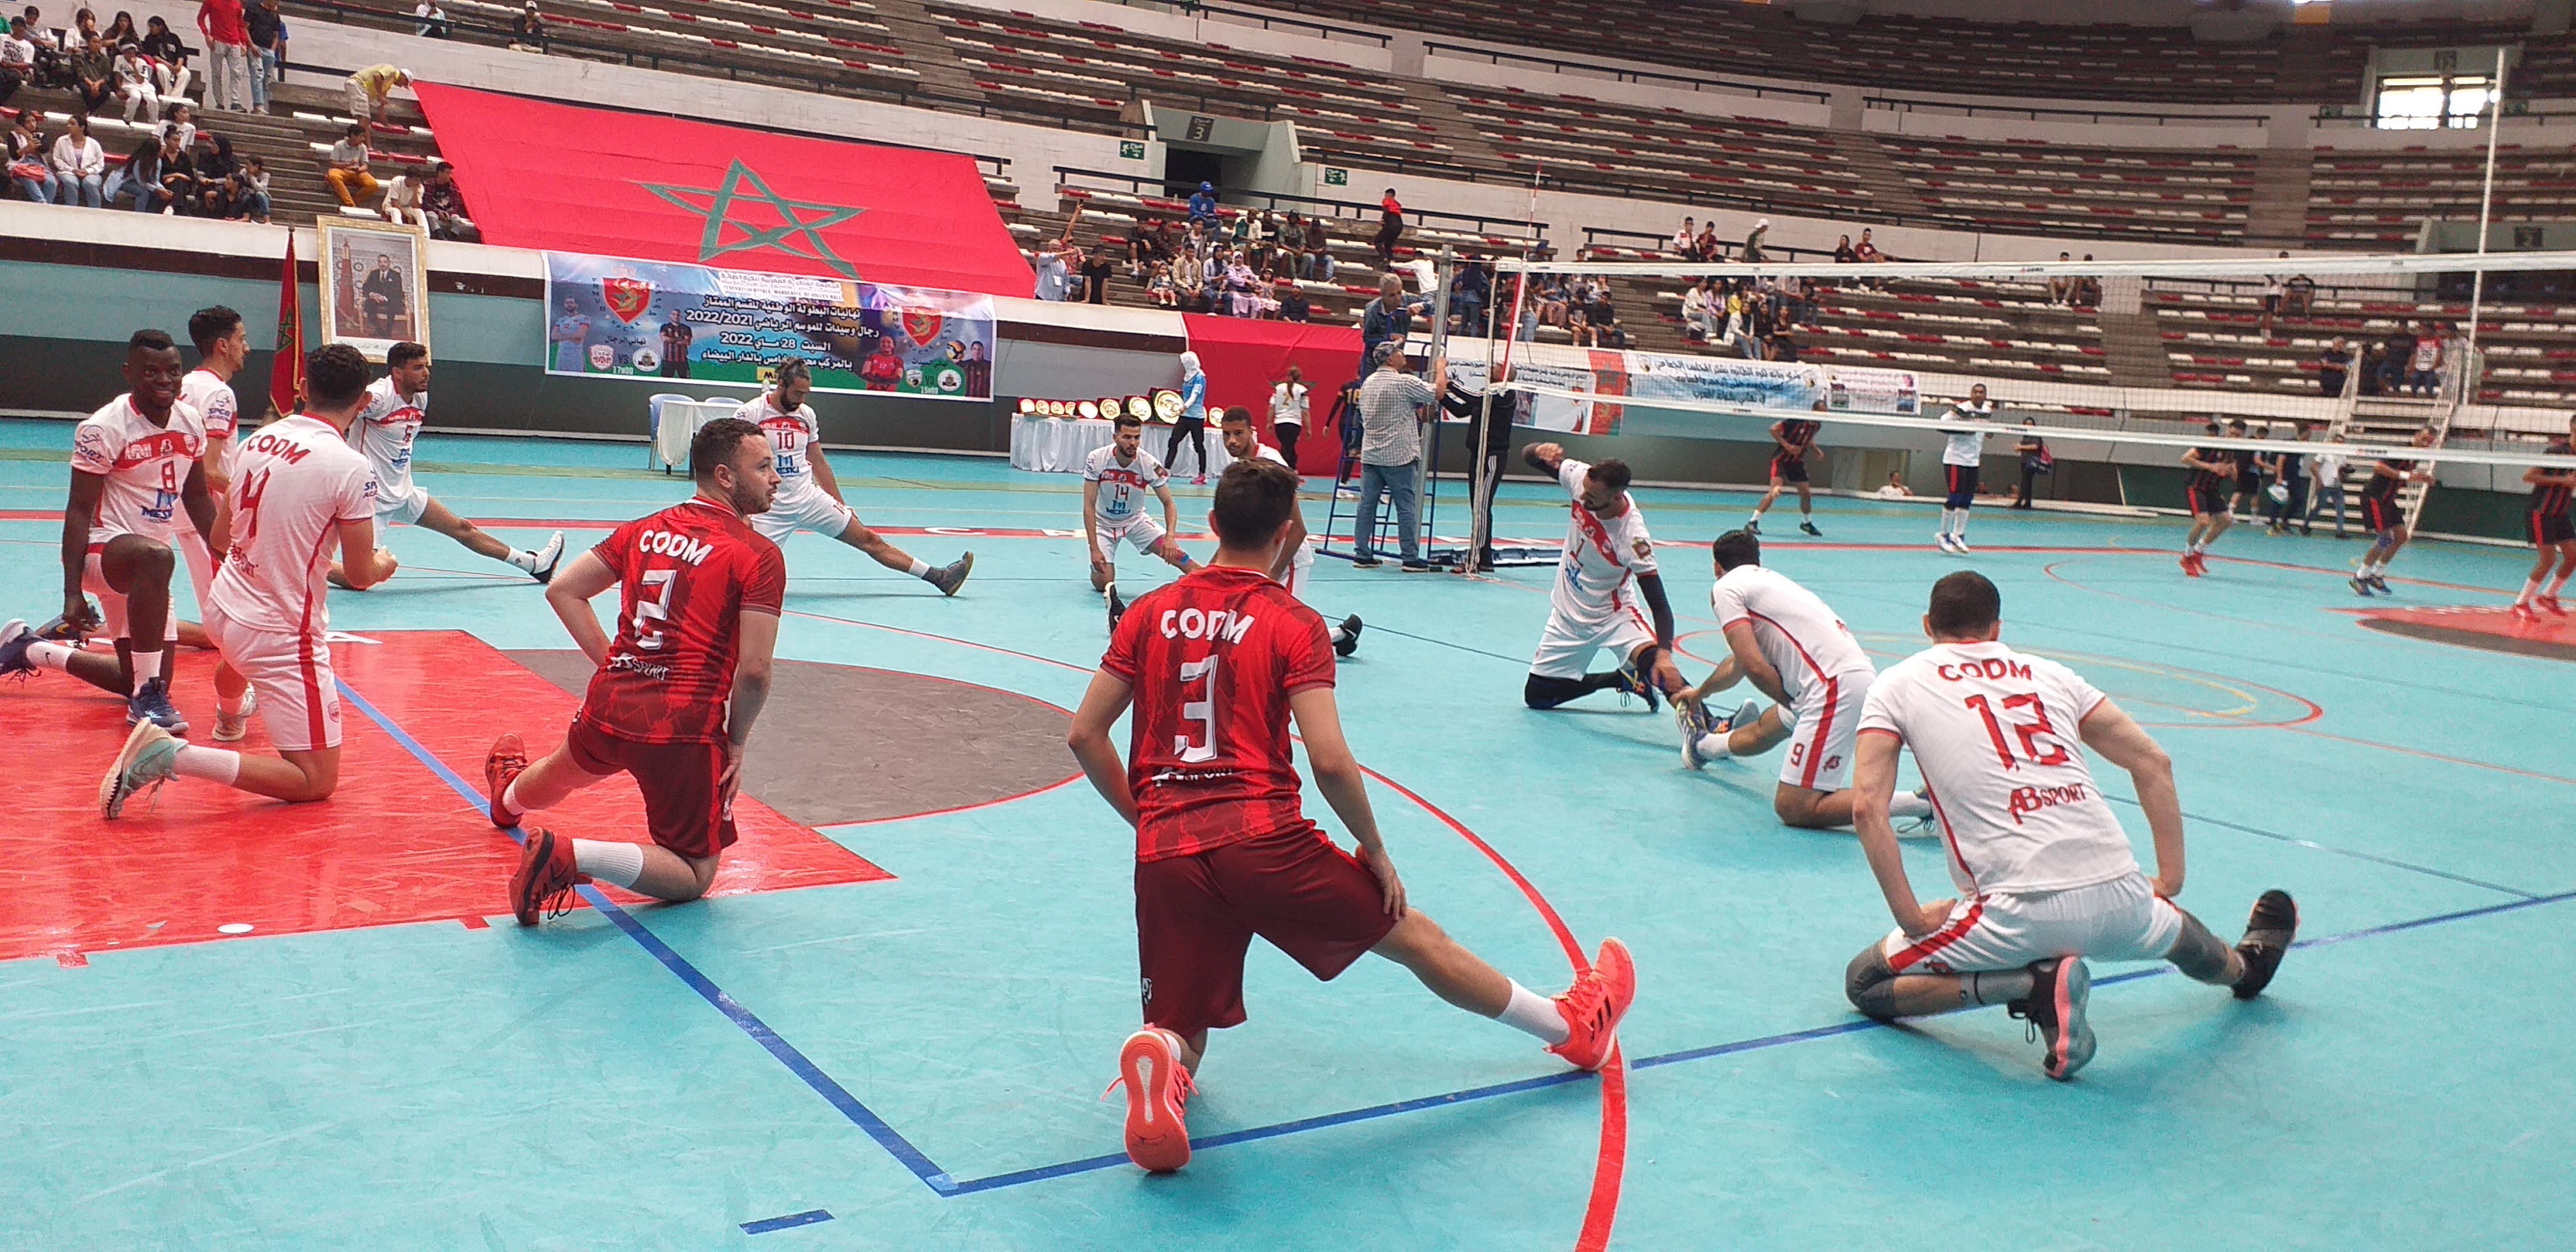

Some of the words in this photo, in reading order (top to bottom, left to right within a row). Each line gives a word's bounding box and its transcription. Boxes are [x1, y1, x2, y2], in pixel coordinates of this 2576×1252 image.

[1193, 126, 1204, 140] 3
[703, 295, 734, 308] الممتاز
[734, 297, 761, 310] للقسم
[761, 299, 795, 315] الوطنية
[685, 309, 753, 326] 2022/2021
[797, 303, 829, 317] البطولة
[754, 317, 792, 332] الرياضي
[793, 321, 823, 333] للموسم
[825, 323, 856, 337] وسيدات
[857, 326, 880, 338] رجال
[720, 332, 754, 346] 2022
[780, 338, 797, 349] 28
[800, 340, 831, 353] السبت
[617, 353, 629, 365] VS
[613, 365, 634, 375] 17H00
[776, 431, 795, 450] 10
[246, 434, 312, 466] CODM
[161, 460, 176, 492] 8
[1115, 484, 1130, 501] 14
[240, 466, 272, 539] 4
[639, 529, 714, 567] CODM
[632, 569, 677, 650] 2
[1160, 607, 1255, 645] CODM
[1937, 657, 2033, 682] CODM
[1174, 653, 1219, 763] 3
[1963, 692, 2071, 772] 12
[1790, 742, 1805, 768] 9
